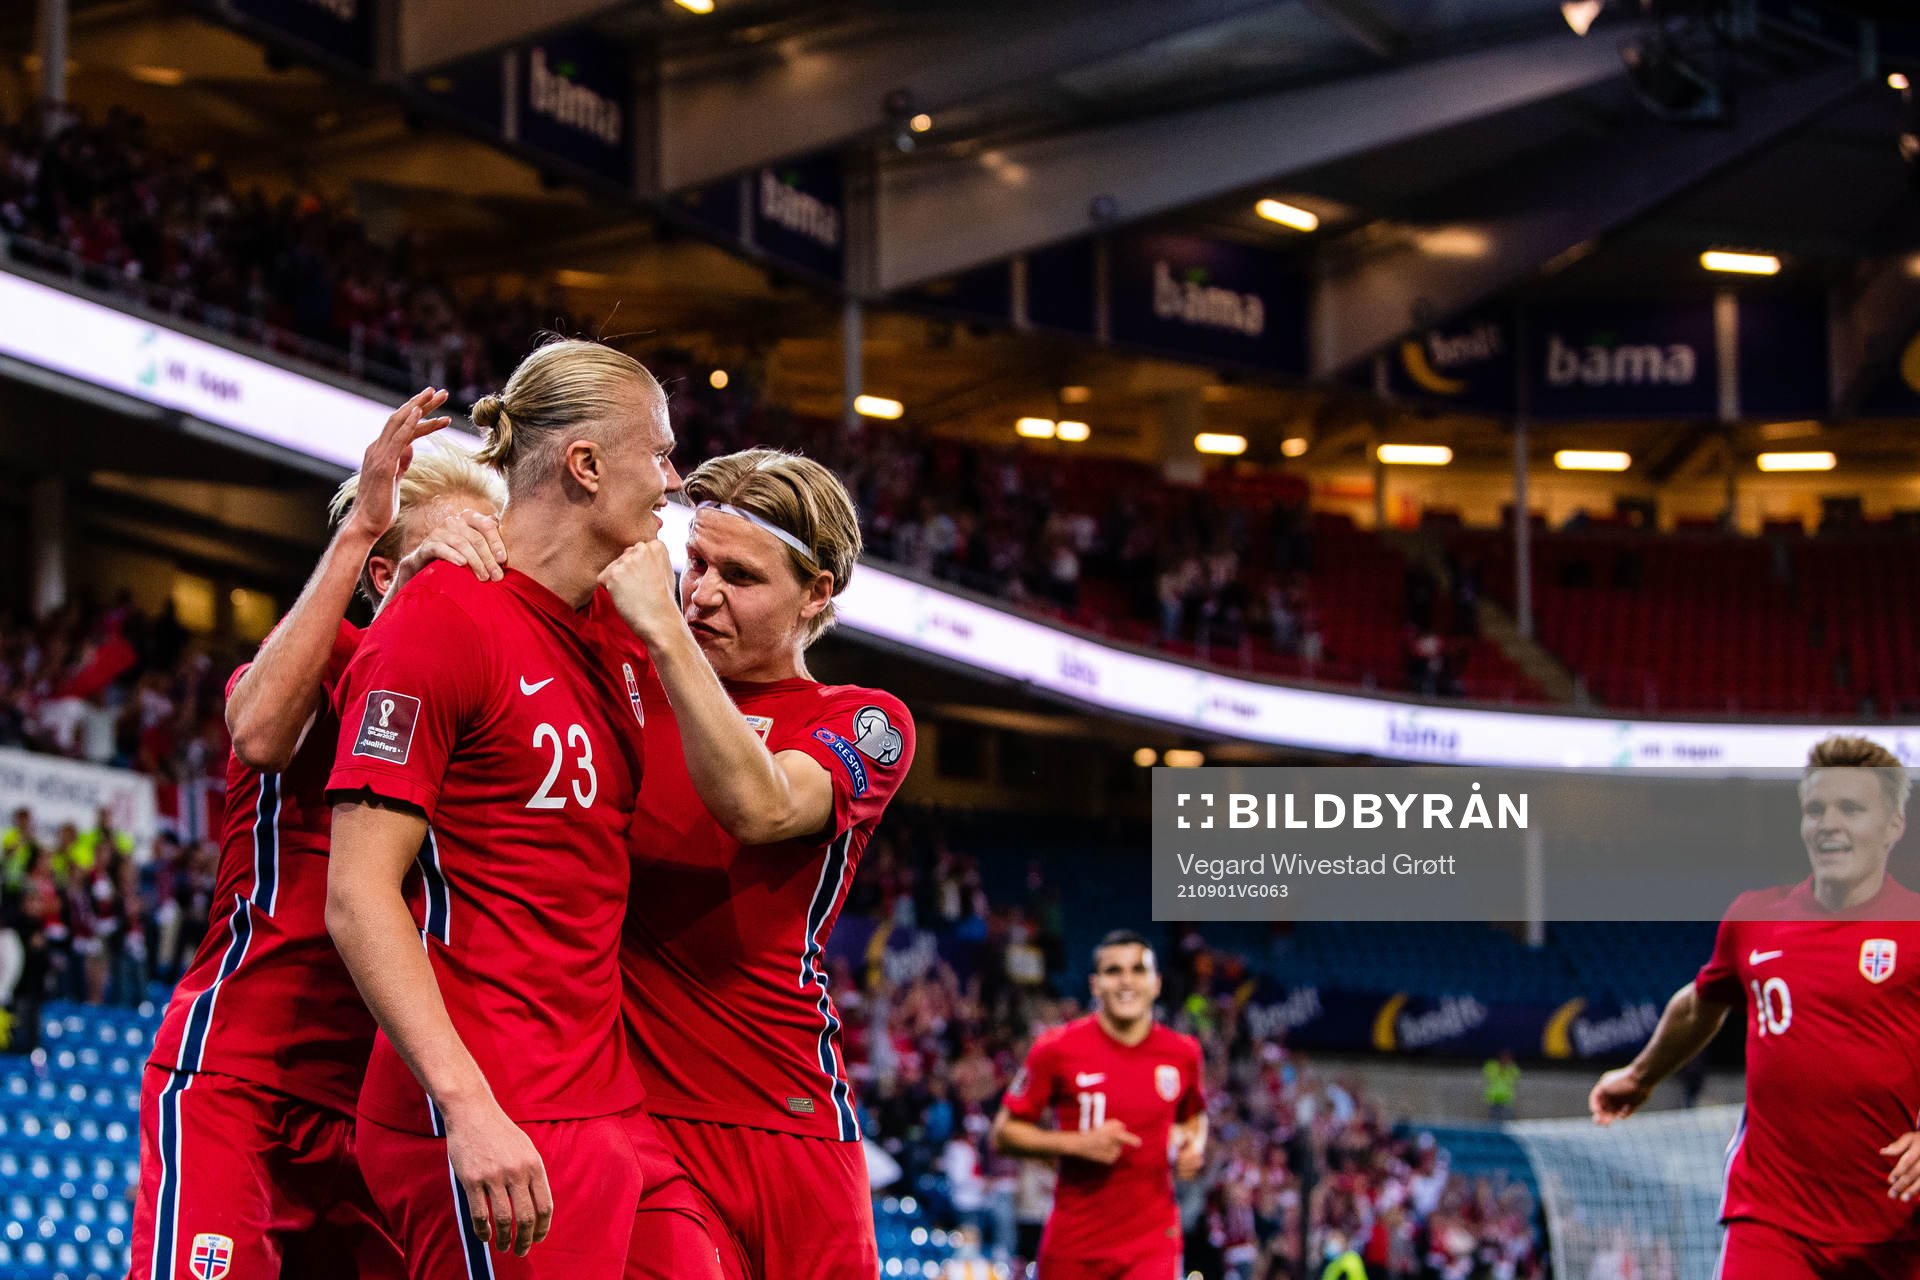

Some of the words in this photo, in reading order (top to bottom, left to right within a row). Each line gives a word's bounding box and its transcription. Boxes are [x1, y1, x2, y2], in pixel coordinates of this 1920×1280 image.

[1547, 334, 1697, 386] bama
[525, 723, 597, 809] 23
[835, 741, 867, 794] RESPECT
[1751, 976, 1793, 1037] 10
